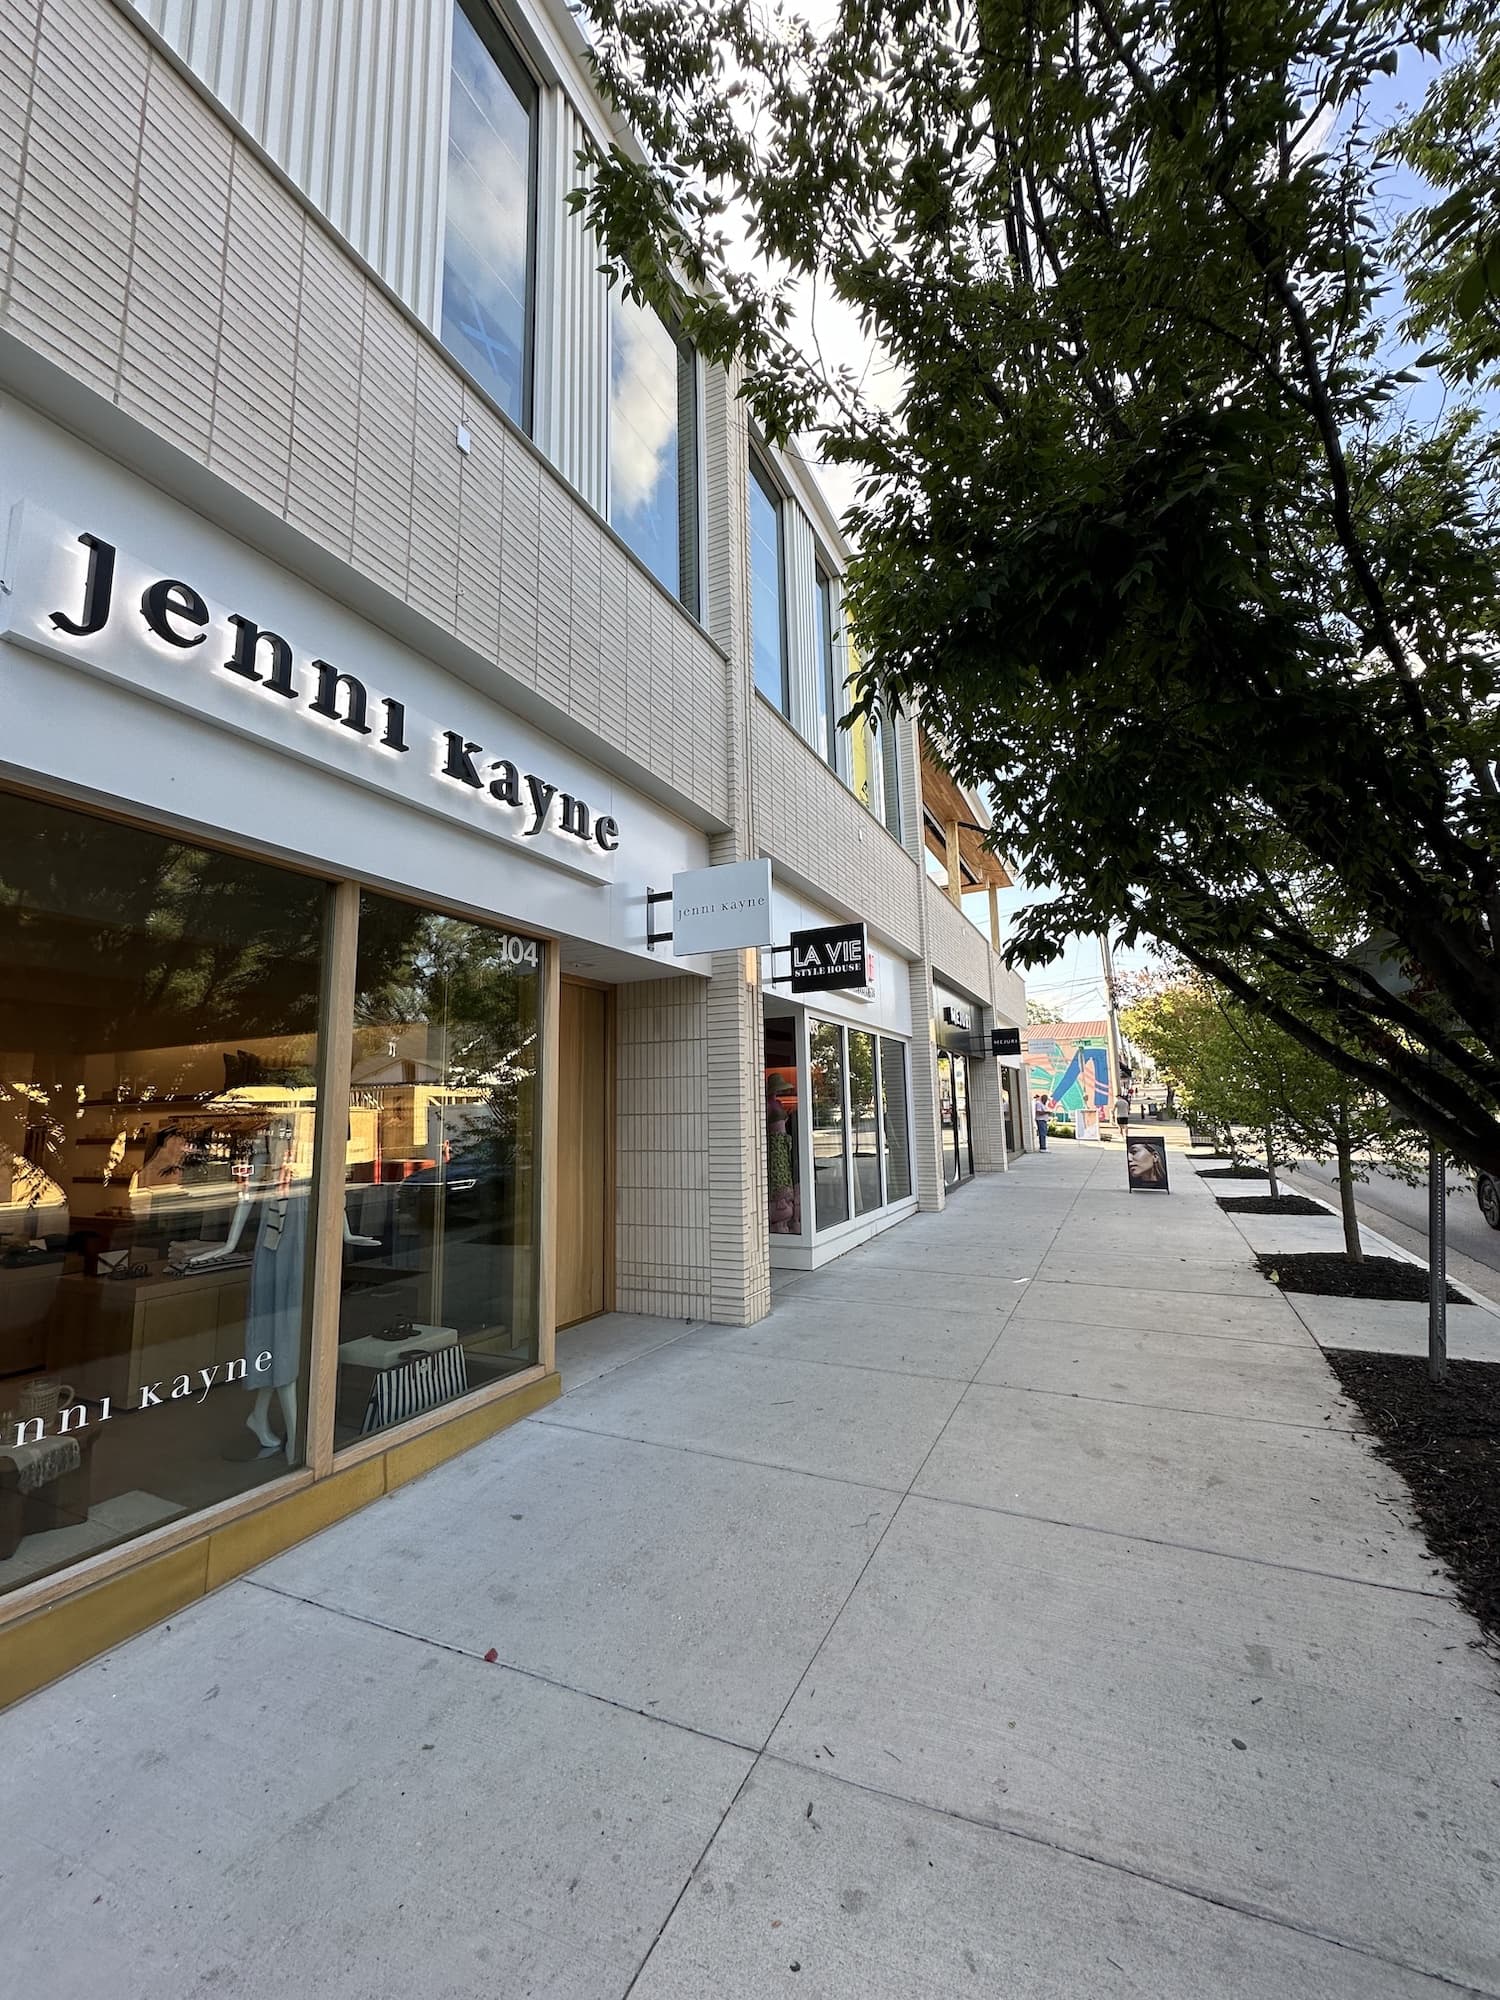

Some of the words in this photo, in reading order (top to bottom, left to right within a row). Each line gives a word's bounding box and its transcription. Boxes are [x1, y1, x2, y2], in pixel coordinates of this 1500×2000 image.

[440, 730, 620, 851] kayne
[677, 904, 715, 921] jenni
[721, 897, 765, 912] kayne
[498, 935, 538, 967] 104
[793, 945, 821, 967] LA
[825, 940, 861, 965] VIE
[794, 967, 826, 977] STYLE
[827, 963, 861, 974] HOUSE
[0, 1396, 112, 1448] nni
[138, 1350, 273, 1410] kayne
